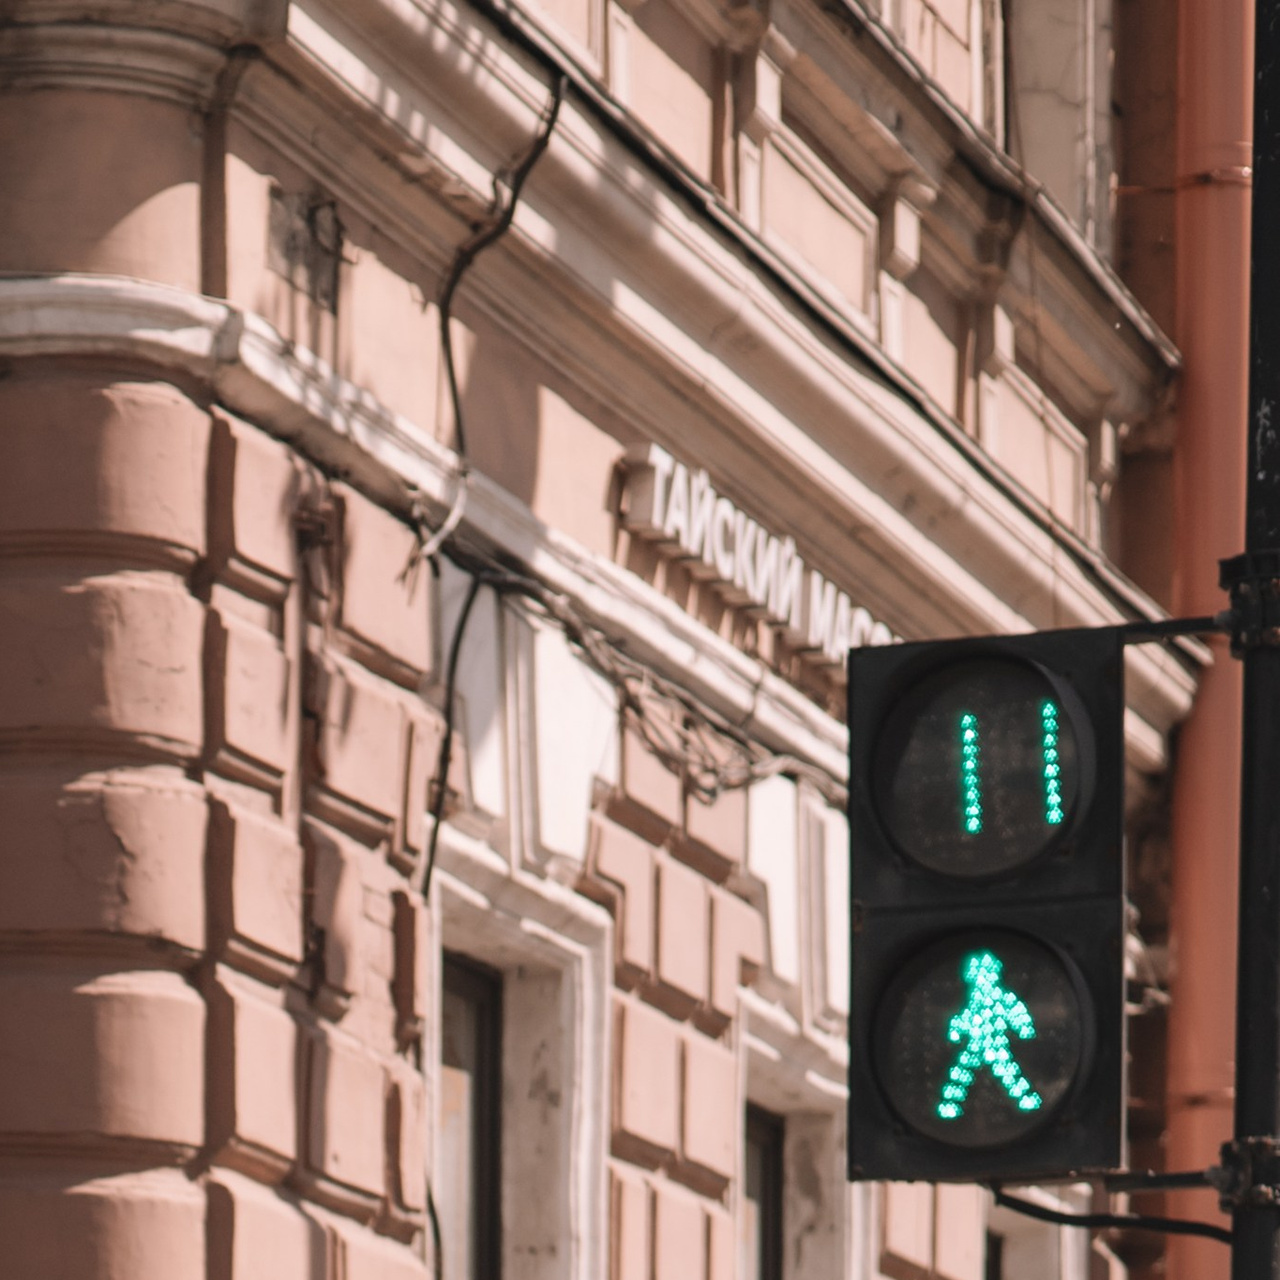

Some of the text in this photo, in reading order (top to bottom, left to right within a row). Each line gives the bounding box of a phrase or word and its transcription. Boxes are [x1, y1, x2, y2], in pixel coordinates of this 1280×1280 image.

[648, 442, 906, 670] ТАЙСКИЙ МАС
[959, 699, 1064, 836] 11
